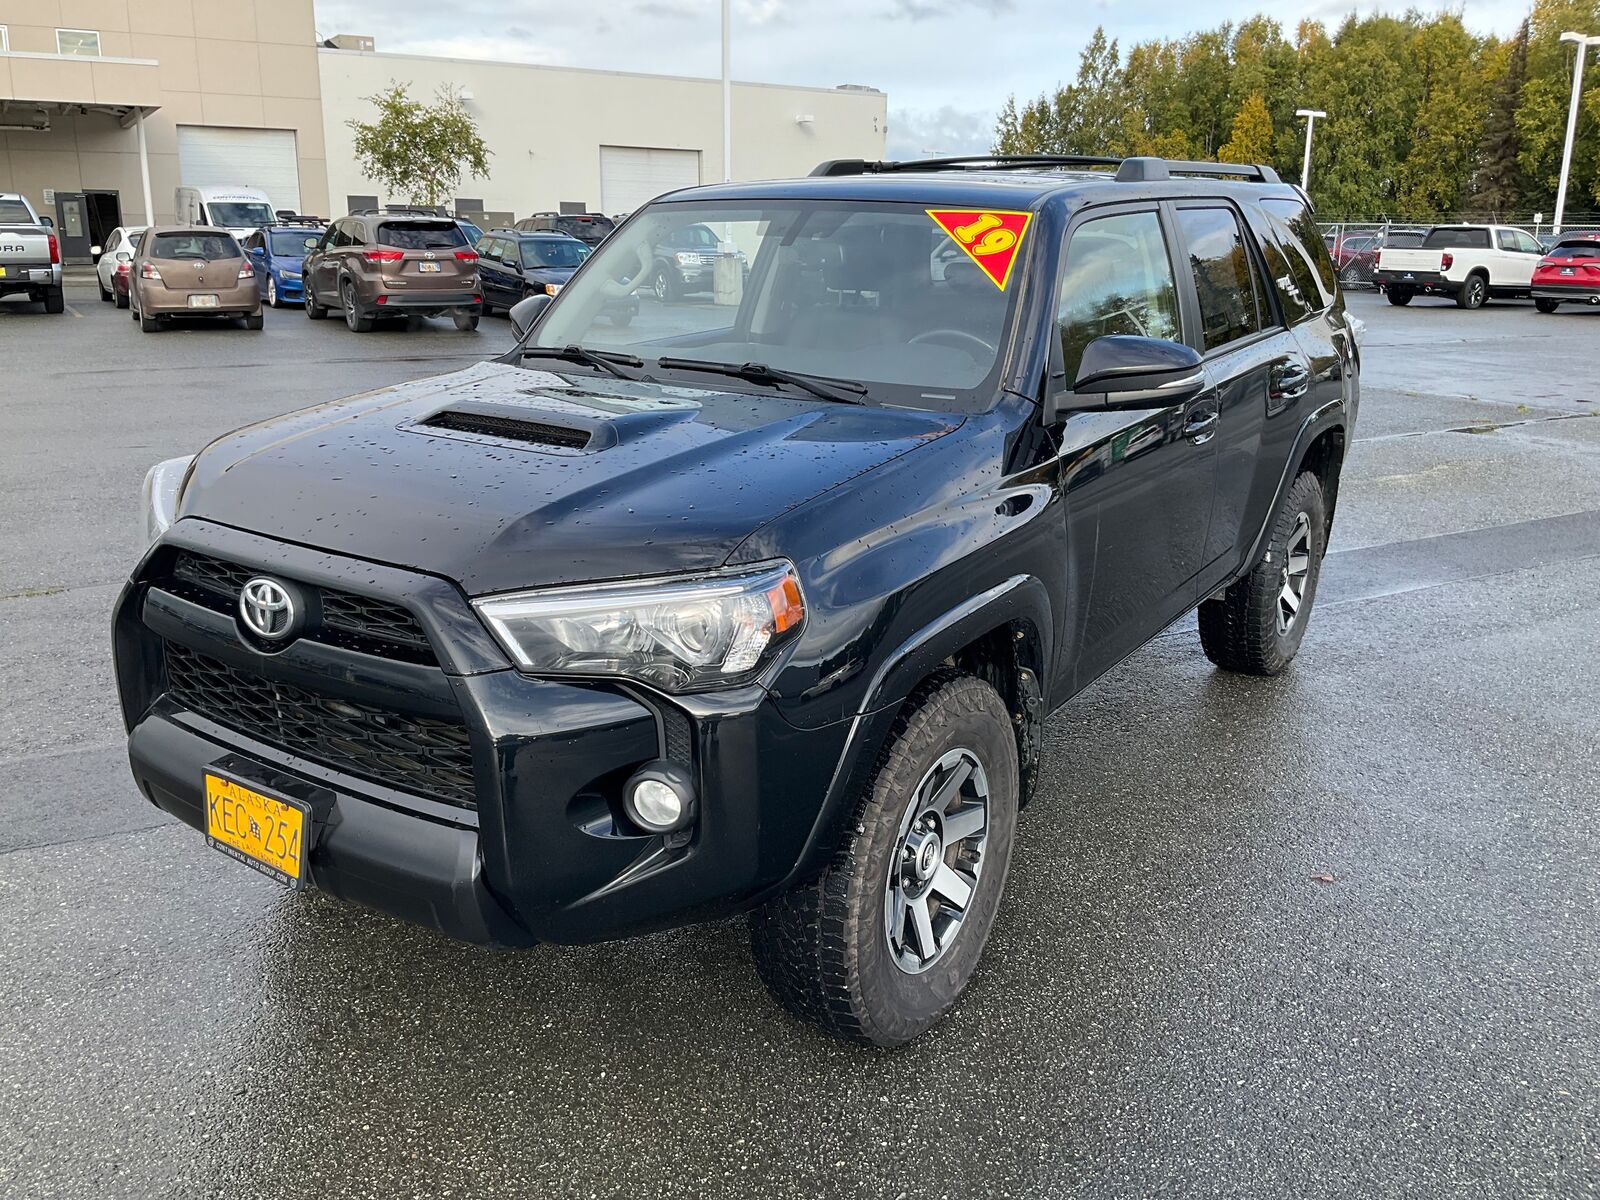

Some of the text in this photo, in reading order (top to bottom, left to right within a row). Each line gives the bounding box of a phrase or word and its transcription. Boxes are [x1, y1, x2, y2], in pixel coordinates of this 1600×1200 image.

[954, 213, 1017, 256] 19
[229, 786, 281, 817] ALASKA
[209, 792, 299, 868] KEC 254
[216, 842, 247, 863] CONTINENTAL
[246, 858, 260, 869] AUTO
